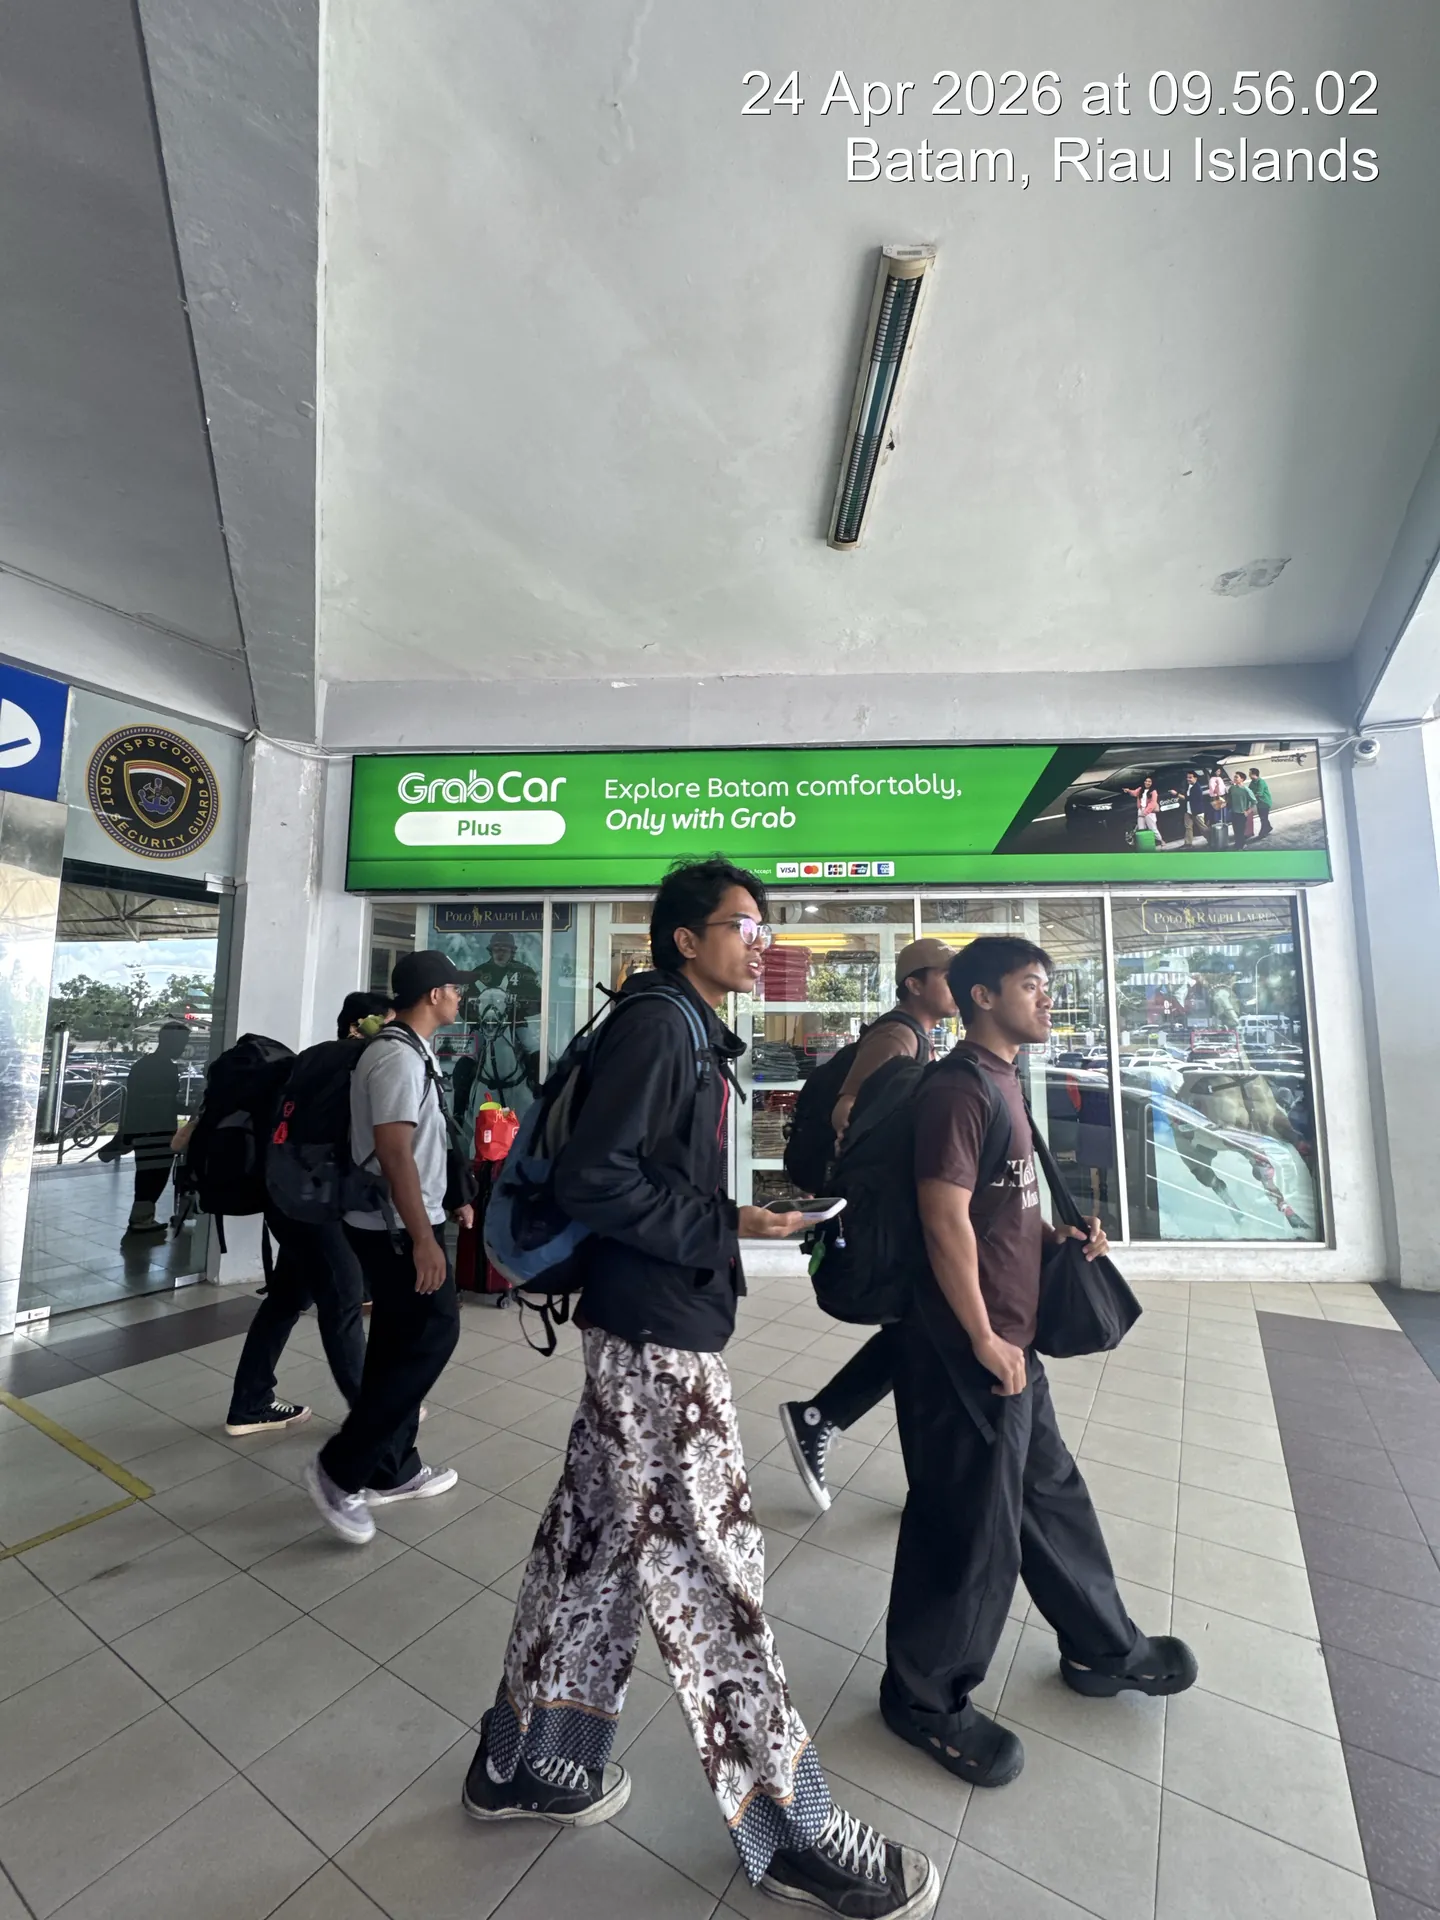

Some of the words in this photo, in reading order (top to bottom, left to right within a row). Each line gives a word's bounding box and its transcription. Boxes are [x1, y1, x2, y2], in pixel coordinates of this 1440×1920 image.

[100, 764, 115, 806] PORT
[604, 777, 701, 804] Explore
[707, 777, 790, 798] Batam
[796, 772, 963, 801] comfortably,
[188, 789, 209, 835] GUARD
[605, 807, 666, 836] Only
[672, 806, 725, 831] with
[730, 805, 797, 830] Grab
[109, 812, 186, 848] SECURITY
[457, 820, 502, 837] Plus
[780, 866, 797, 874] VISA
